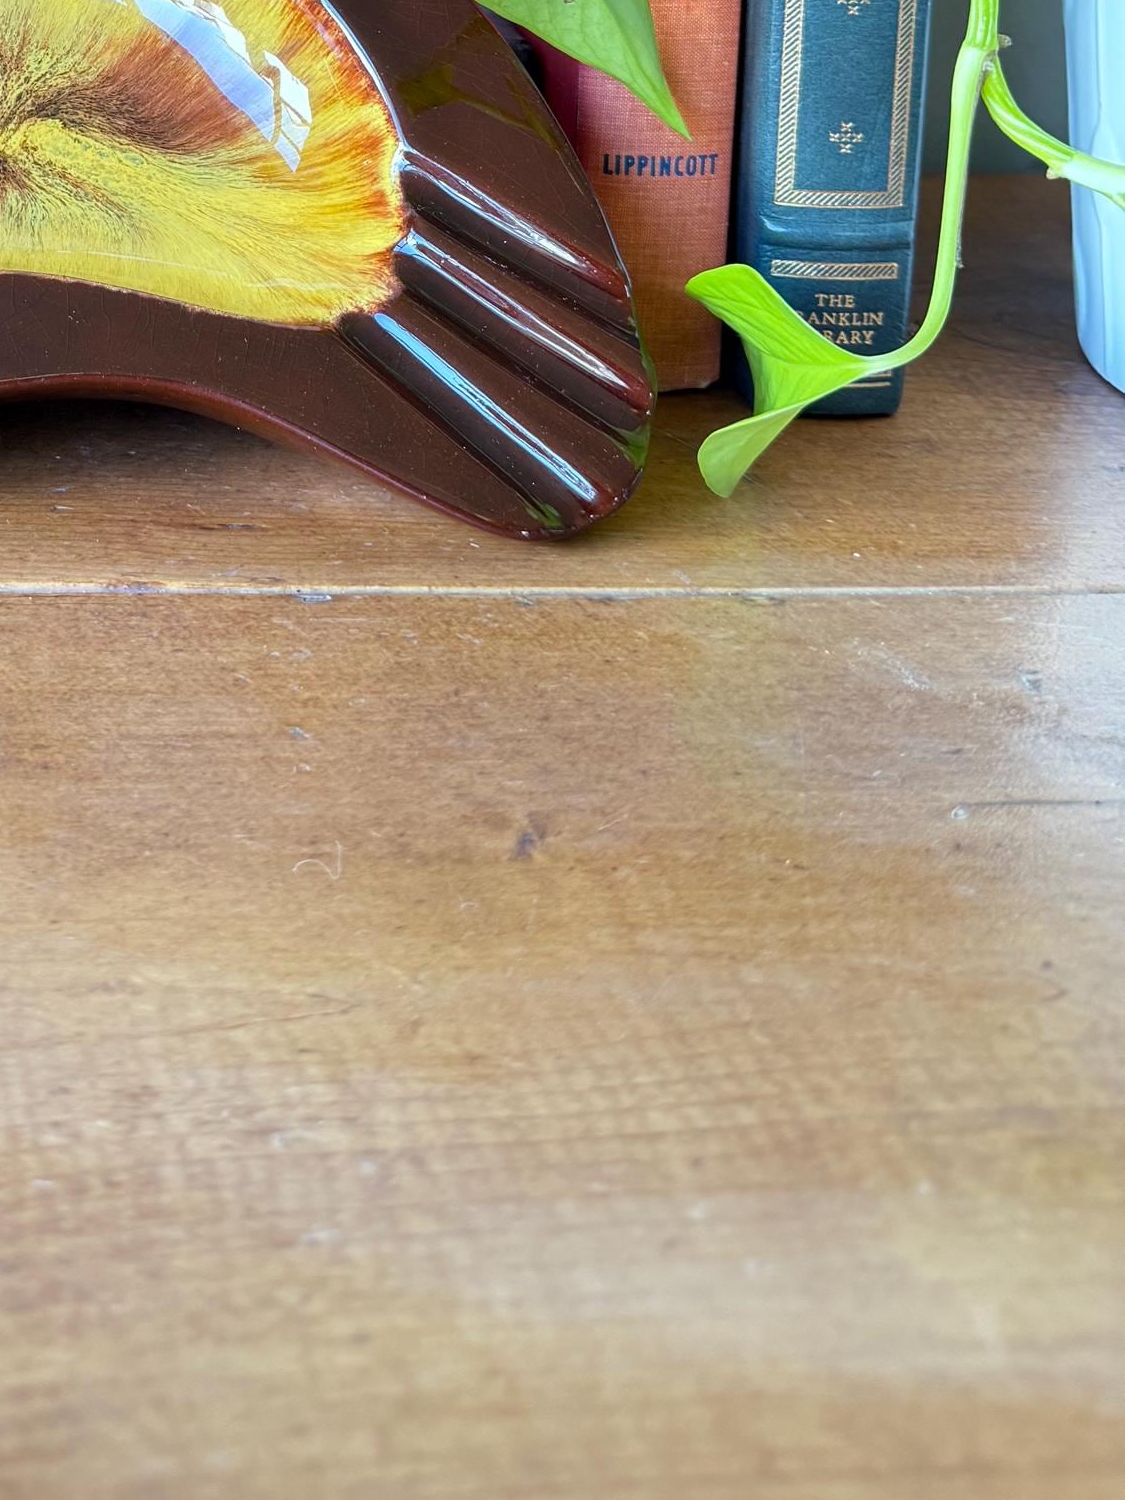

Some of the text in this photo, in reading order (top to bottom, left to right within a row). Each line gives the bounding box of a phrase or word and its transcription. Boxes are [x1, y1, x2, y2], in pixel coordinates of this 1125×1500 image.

[603, 153, 718, 177] LIPPINCOTT
[814, 293, 855, 308] THE
[796, 310, 883, 326] ANKLIN
[822, 330, 874, 345] RARY
